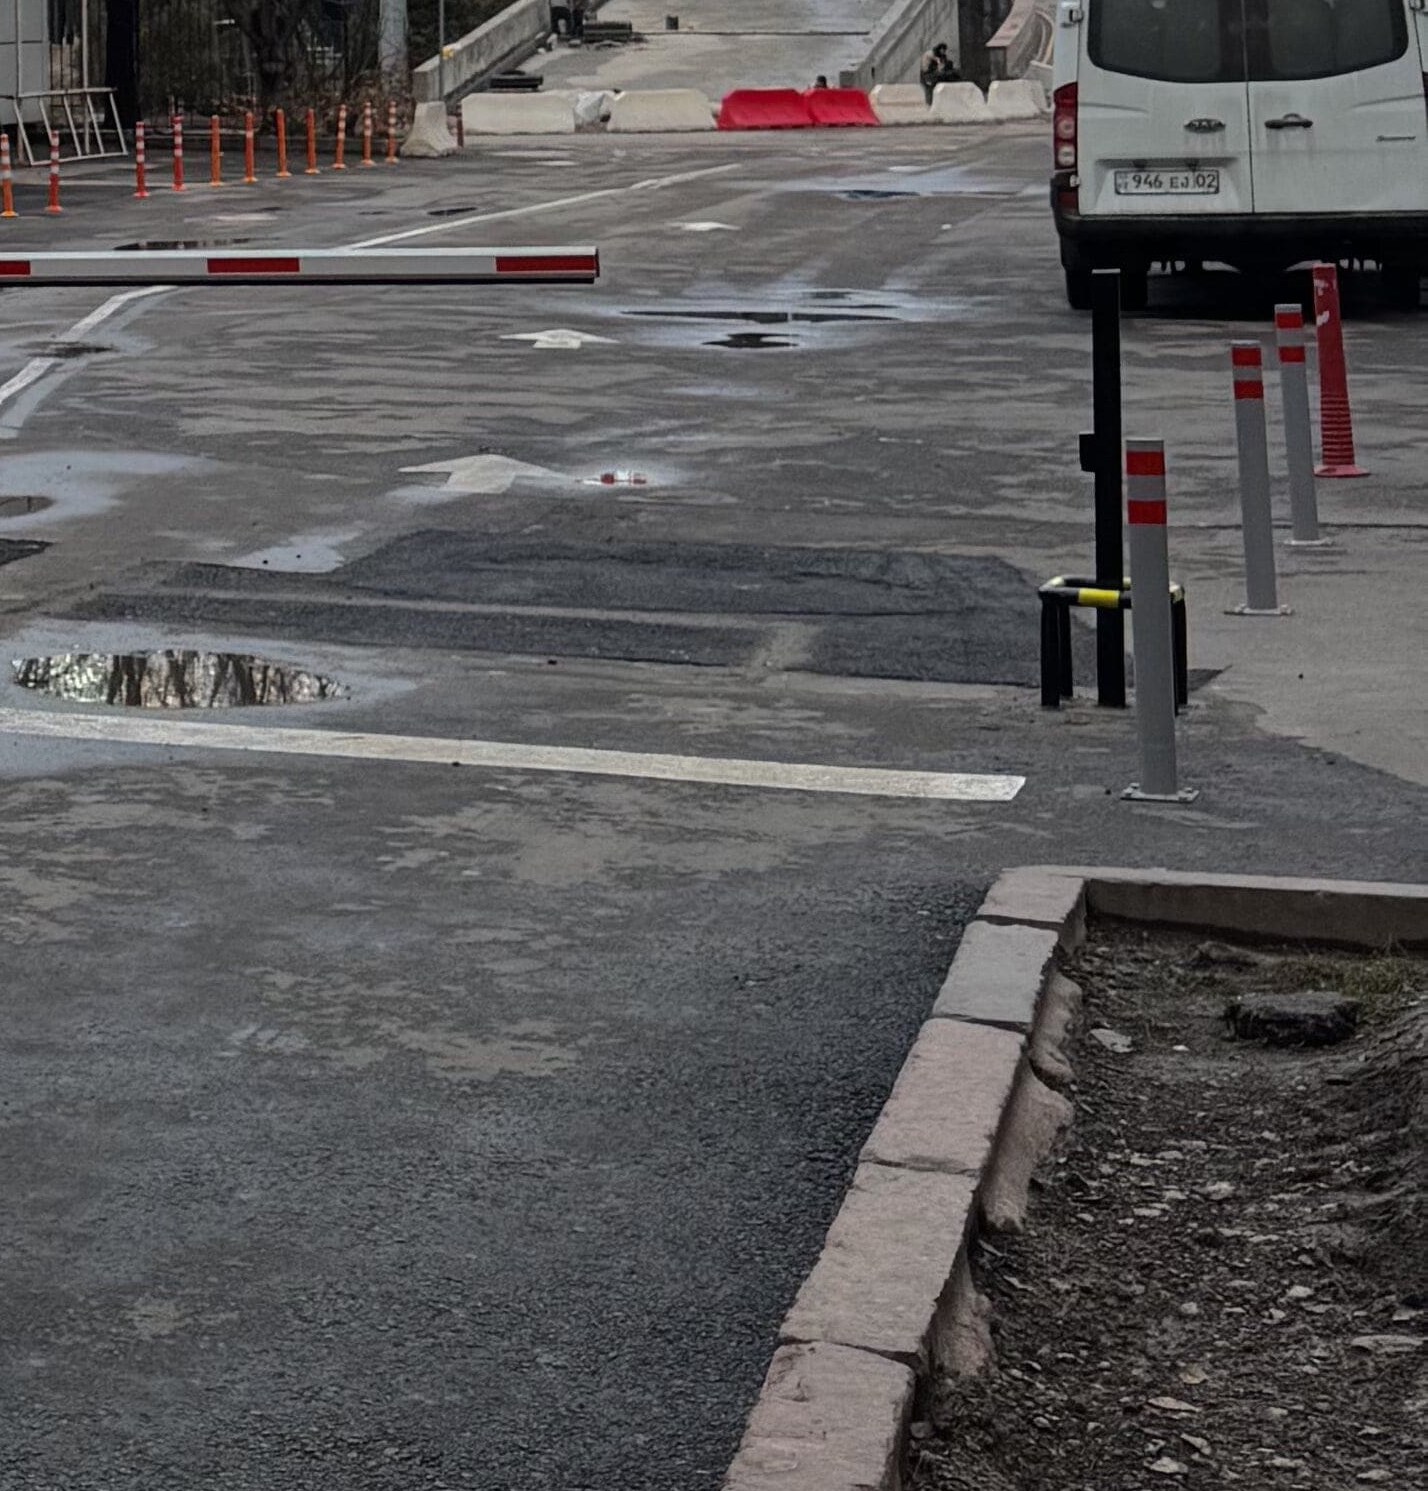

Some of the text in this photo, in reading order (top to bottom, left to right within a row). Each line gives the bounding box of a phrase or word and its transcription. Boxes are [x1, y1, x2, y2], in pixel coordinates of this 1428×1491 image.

[1132, 174, 1216, 189] 946 EJ 02
